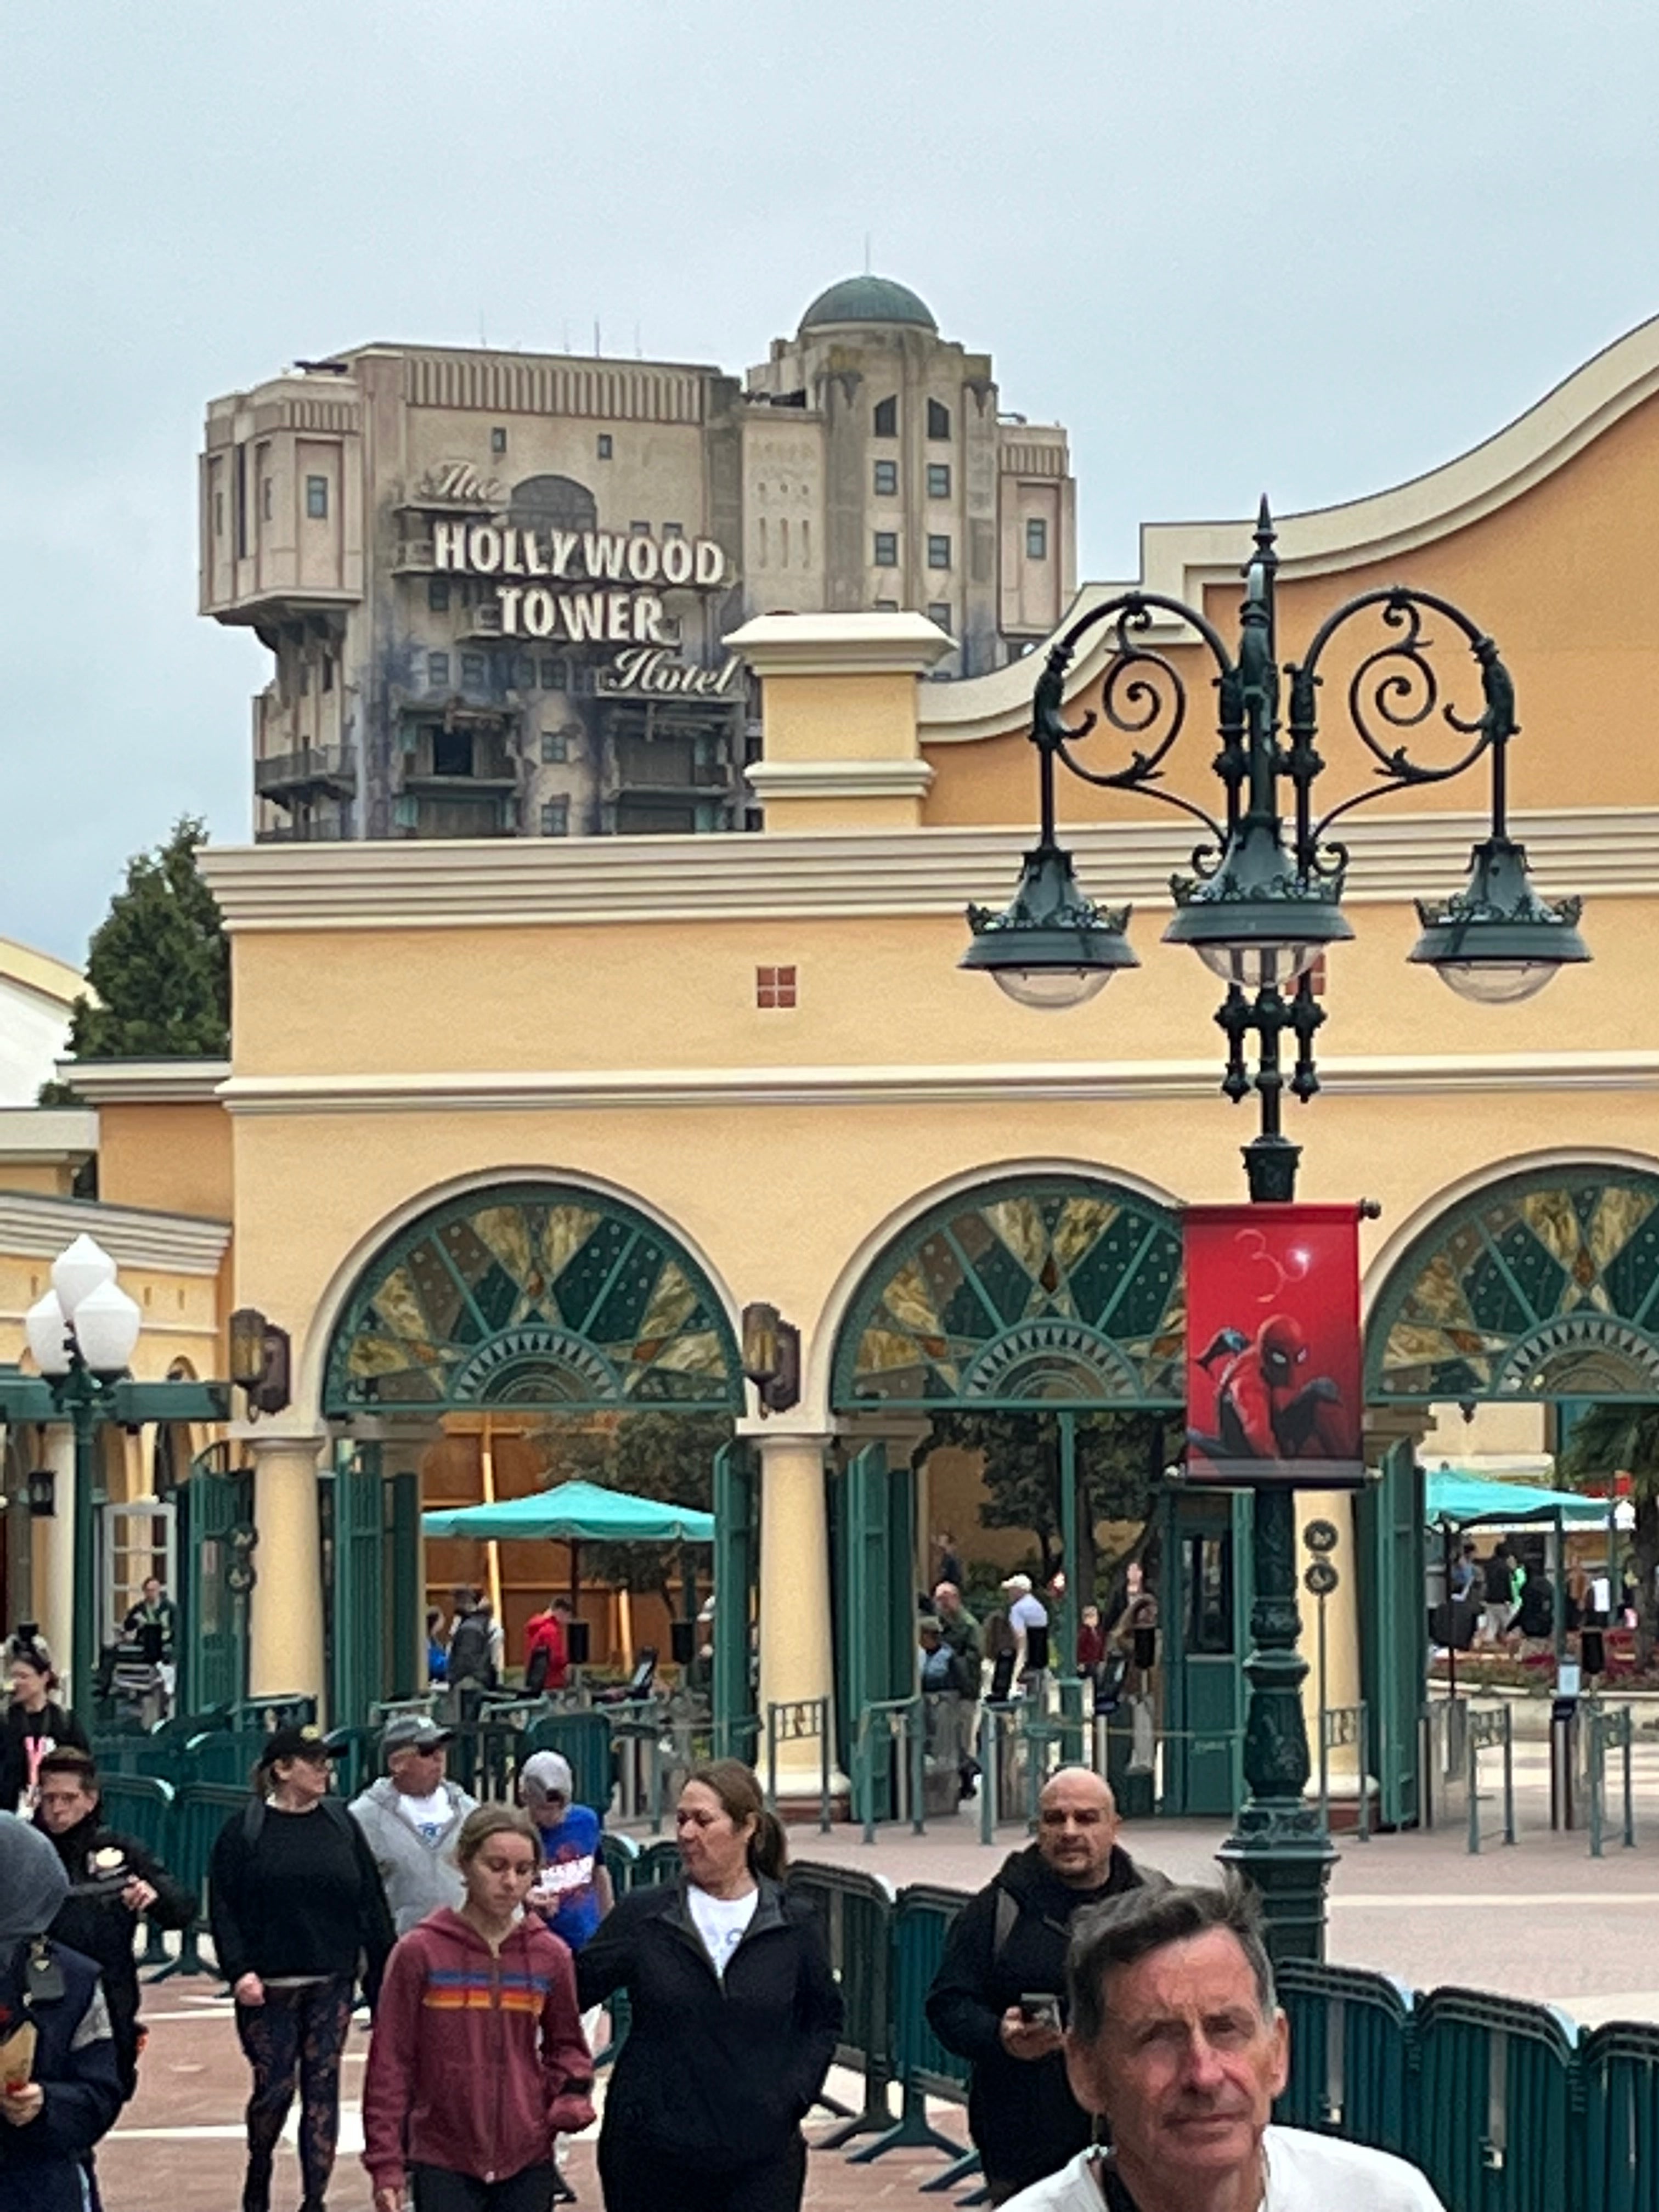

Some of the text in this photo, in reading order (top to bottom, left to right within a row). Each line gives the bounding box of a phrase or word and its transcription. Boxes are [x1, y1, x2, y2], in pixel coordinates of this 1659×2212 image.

[419, 461, 501, 500] The
[435, 521, 725, 584] HOLLYWOOD
[496, 586, 663, 642] TOWER
[608, 647, 741, 694] Hotel
